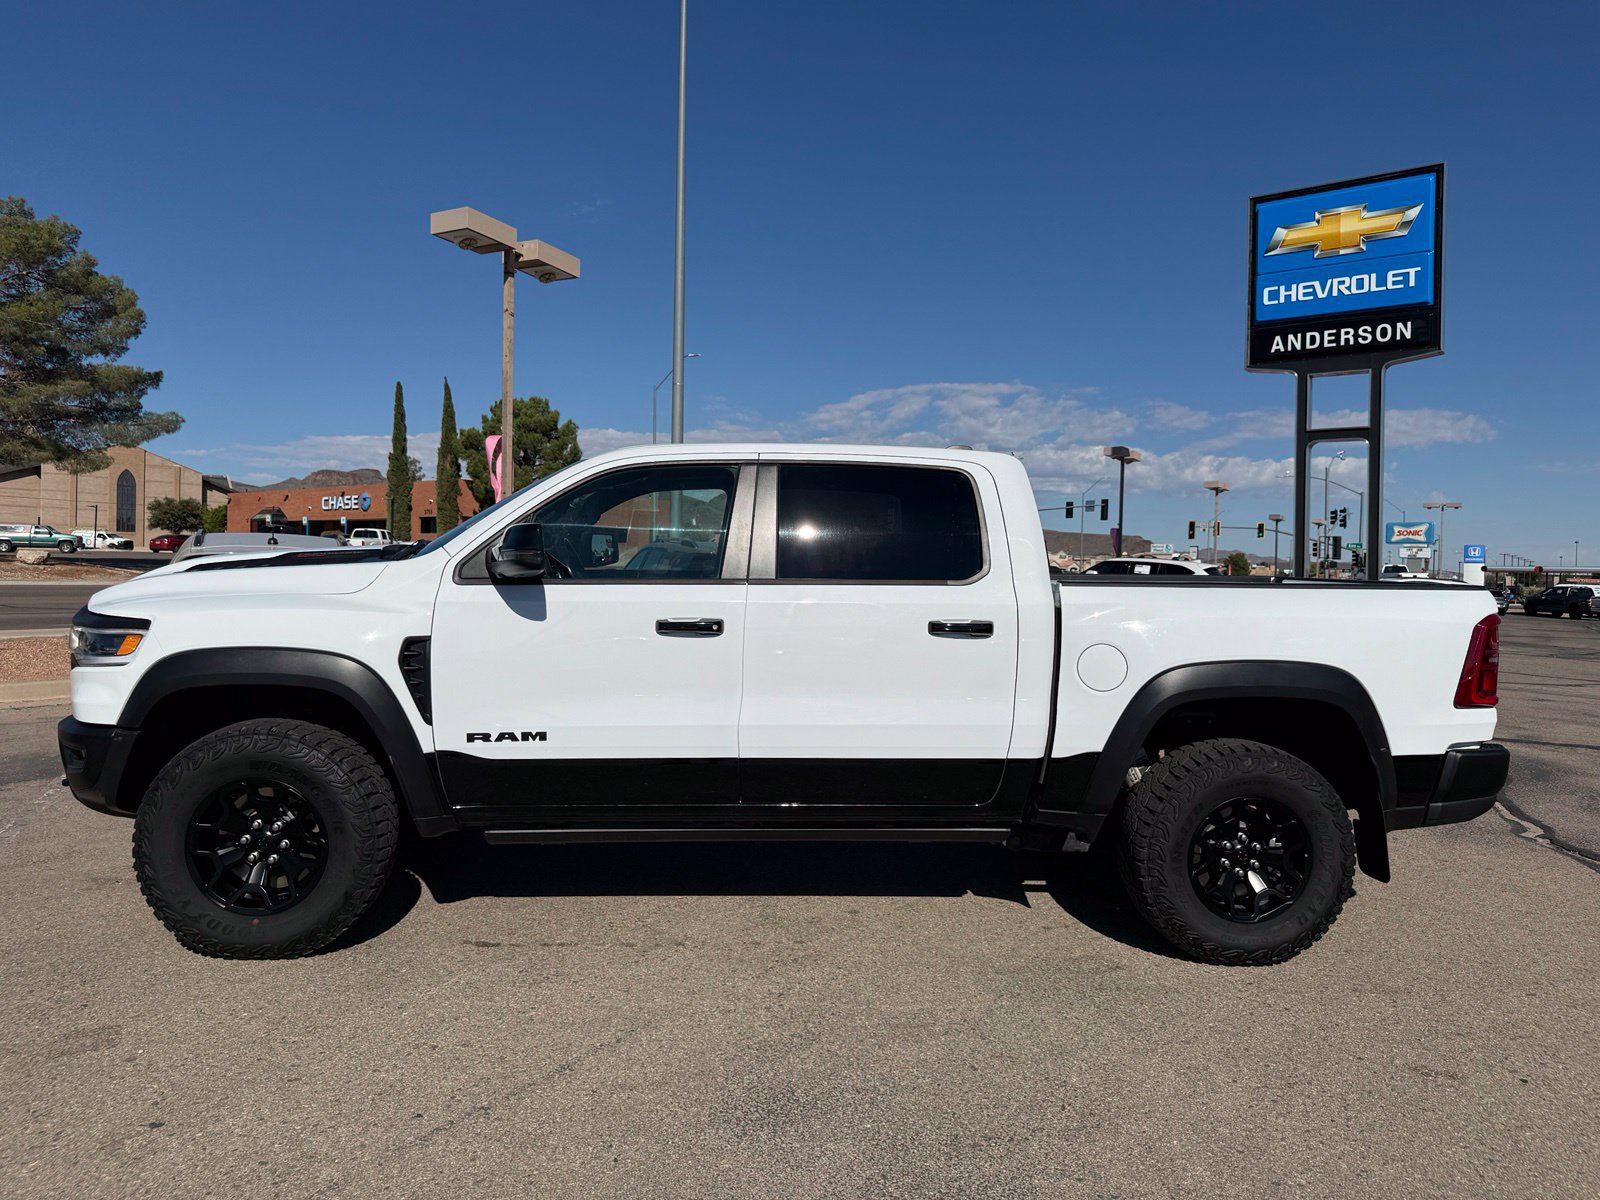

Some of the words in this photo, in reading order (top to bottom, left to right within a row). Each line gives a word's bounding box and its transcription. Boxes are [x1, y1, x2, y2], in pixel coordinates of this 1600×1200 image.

[1263, 267, 1421, 305] CHEVROLET
[1270, 321, 1412, 353] ANDERSON
[322, 495, 359, 510] CHASE
[1396, 529, 1423, 537] SONIC
[466, 731, 547, 743] RAM
